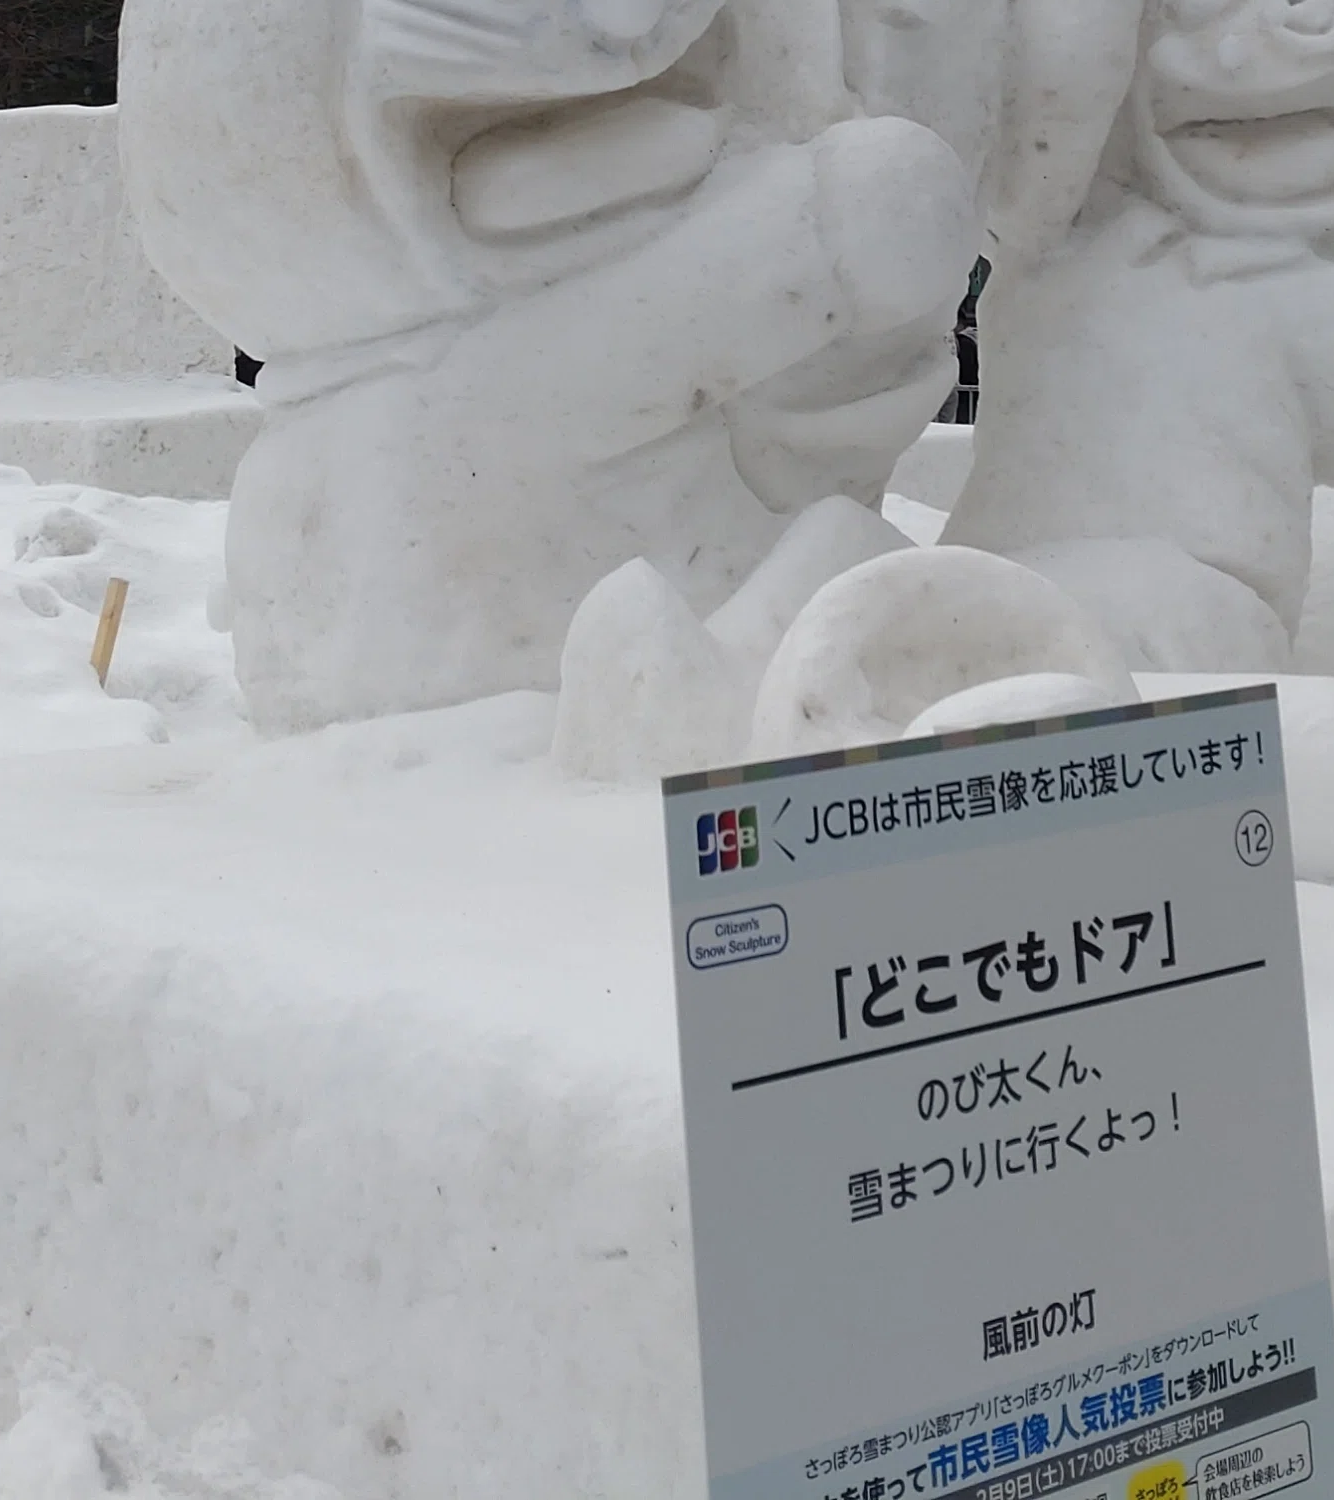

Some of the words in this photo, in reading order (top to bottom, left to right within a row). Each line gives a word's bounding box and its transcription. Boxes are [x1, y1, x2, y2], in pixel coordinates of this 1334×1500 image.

[1241, 823, 1268, 854] 12
[715, 917, 759, 937] Citizen's
[695, 945, 727, 960] Snow
[728, 934, 781, 953] Sculpture
[834, 901, 1177, 1040] 「どこでもドア」
[917, 1044, 1103, 1121] のび太くん、
[982, 1288, 1097, 1361] 風前の灯
[1203, 1447, 1264, 1483] 会場周辺の
